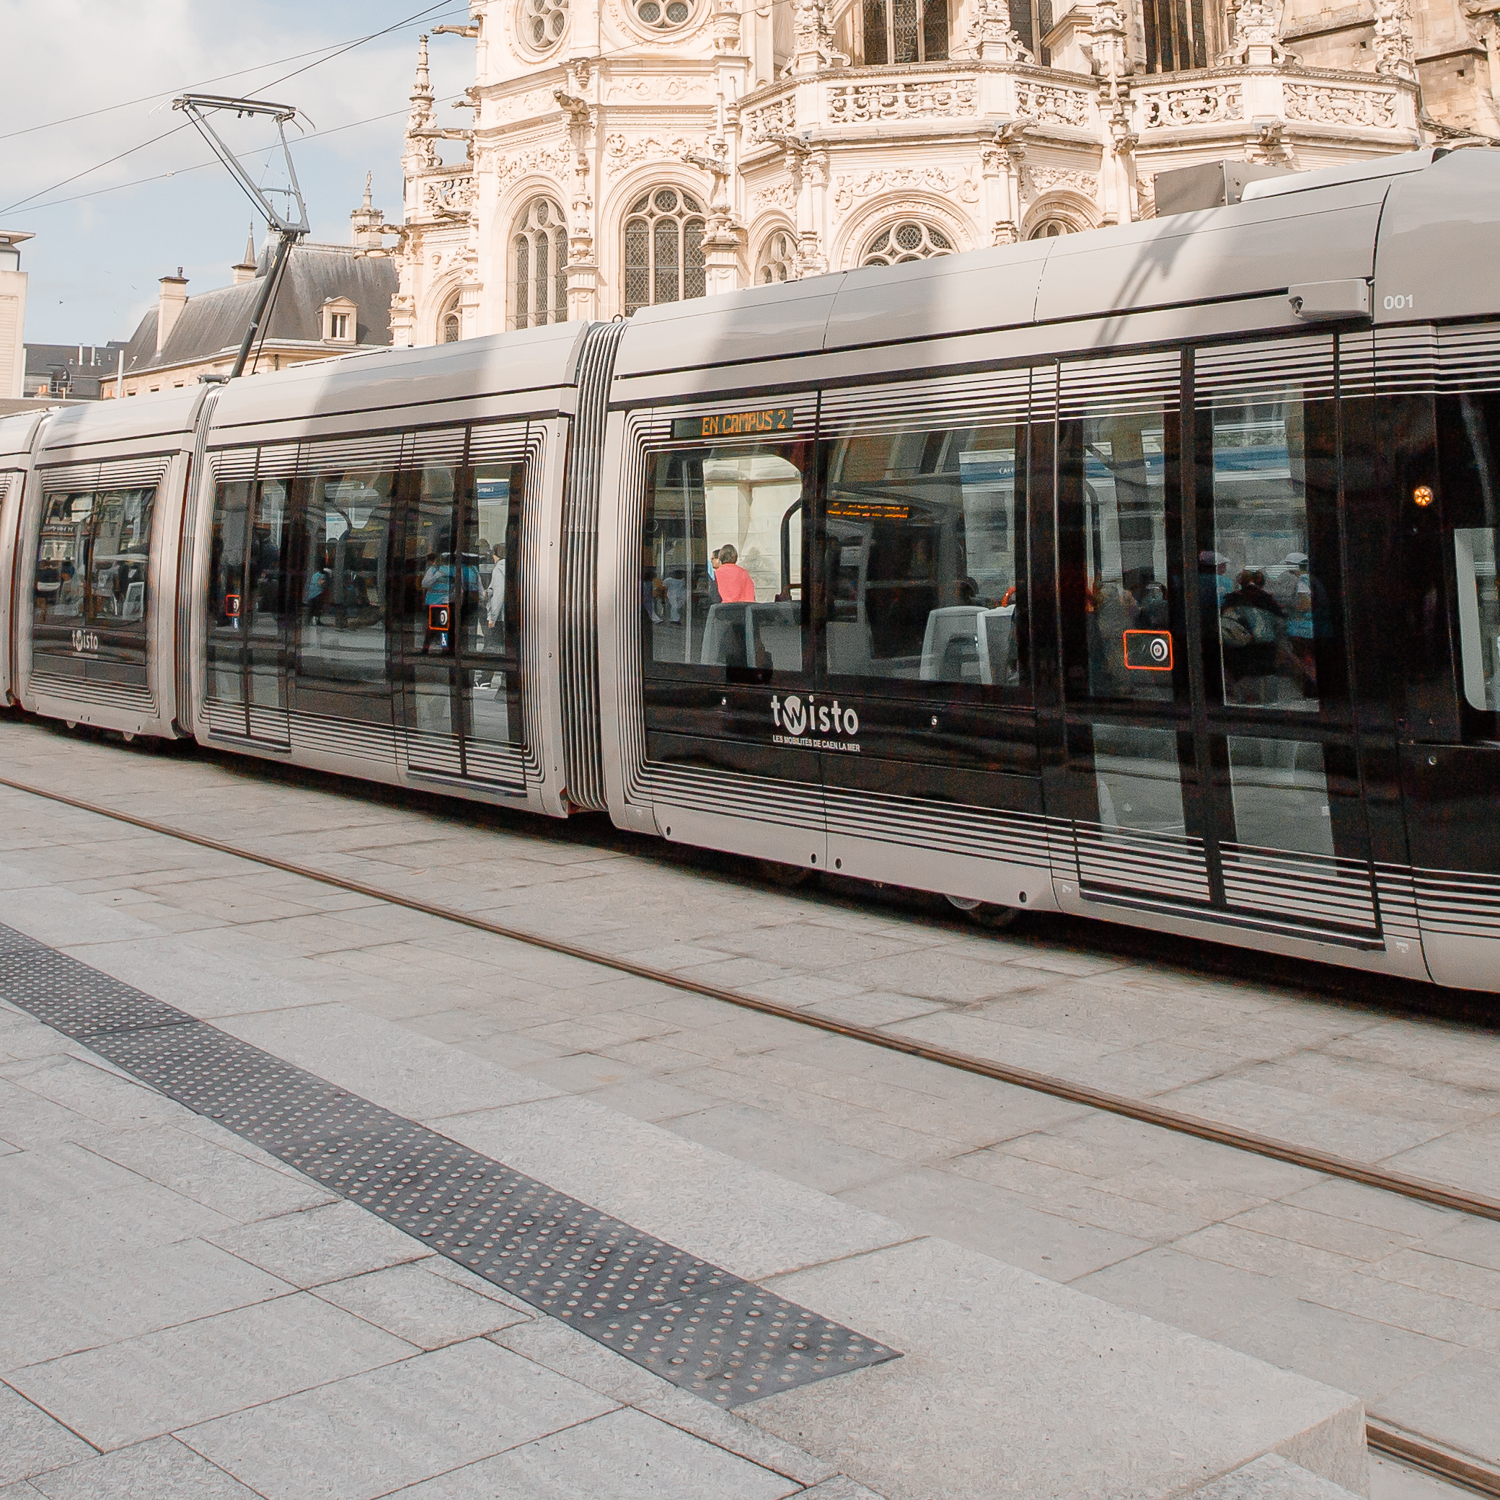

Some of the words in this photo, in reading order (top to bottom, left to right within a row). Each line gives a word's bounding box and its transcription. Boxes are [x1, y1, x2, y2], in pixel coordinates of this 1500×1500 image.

[1383, 293, 1414, 310] 001
[701, 416, 719, 436] EN
[722, 410, 773, 435] CAMPUS
[777, 409, 787, 429] 2
[71, 629, 99, 652] twisto
[771, 694, 859, 735] twisto
[772, 735, 783, 743] LES
[783, 736, 812, 746] MOBILITÉS
[813, 739, 821, 748] DE
[821, 740, 838, 749] CAEN
[838, 742, 847, 751] LA
[847, 743, 860, 752] MER
